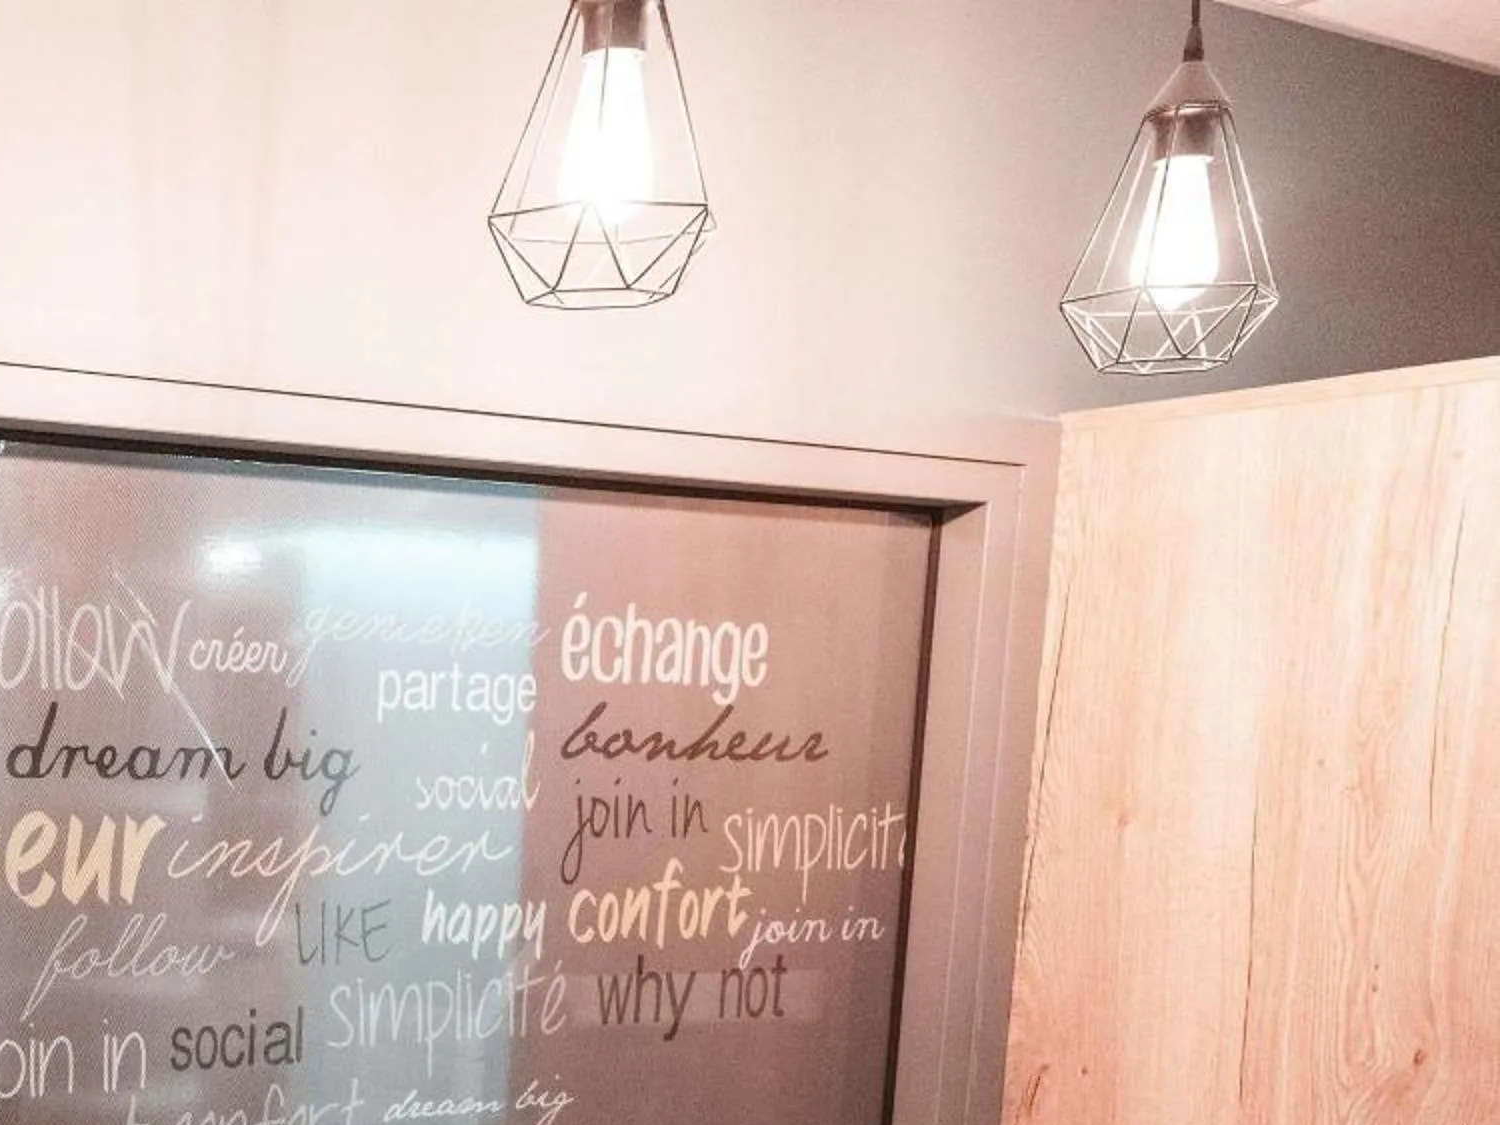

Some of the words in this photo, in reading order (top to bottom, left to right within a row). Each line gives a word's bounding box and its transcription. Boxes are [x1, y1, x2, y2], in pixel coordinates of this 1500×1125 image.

[188, 625, 290, 673] créer
[561, 592, 769, 705] échange
[378, 662, 537, 724] partage
[561, 701, 829, 764] bonheur
[6, 701, 245, 781] dream
[263, 707, 362, 815] big
[415, 729, 541, 812] social
[560, 779, 652, 886] join
[671, 778, 708, 841] in
[167, 813, 513, 947] inspirer
[568, 857, 752, 944] confort
[295, 899, 393, 967] LIKE
[421, 889, 545, 960] happy
[740, 908, 833, 969] join
[841, 905, 885, 941] in
[22, 913, 235, 1020] follow
[599, 955, 698, 1041] why
[717, 954, 788, 1018] not
[102, 1018, 148, 1096] in
[170, 1006, 303, 1071] social
[326, 958, 567, 1077] simplicité
[385, 1088, 504, 1123] dream
